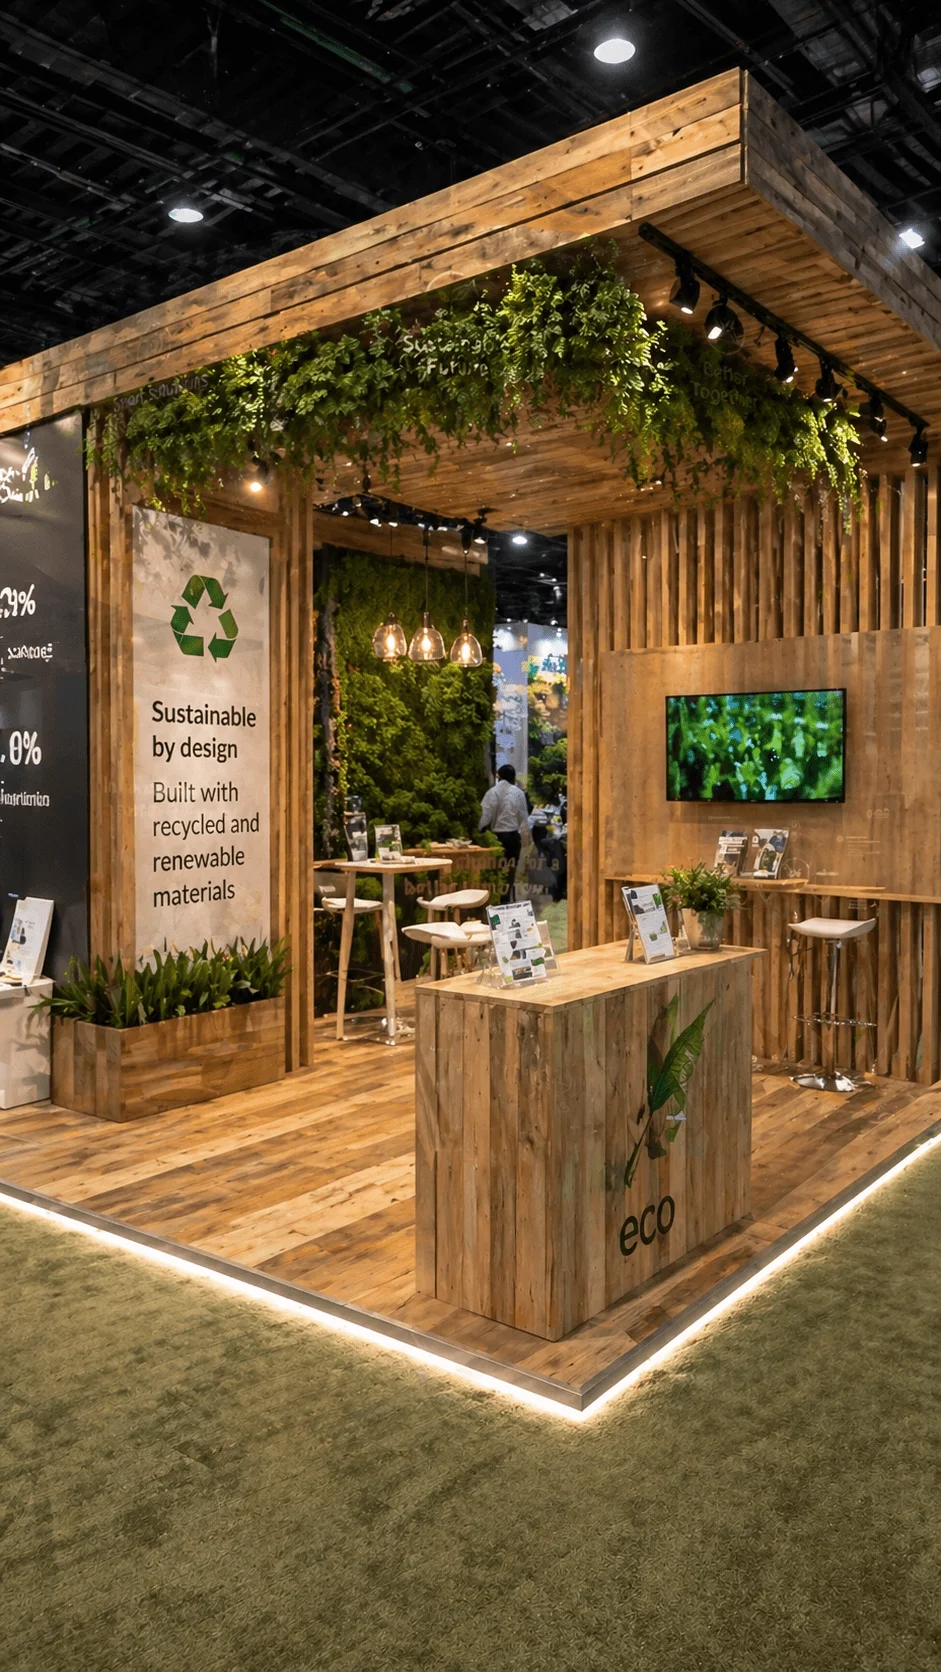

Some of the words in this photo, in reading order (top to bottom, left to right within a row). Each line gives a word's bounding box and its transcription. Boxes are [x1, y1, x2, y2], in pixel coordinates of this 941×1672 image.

[152, 700, 257, 728] Sustainable
[152, 735, 176, 763] by
[180, 736, 238, 764] design
[153, 781, 196, 803] Built
[200, 781, 239, 802] with
[153, 812, 226, 841] recycled
[230, 811, 260, 834] and
[153, 845, 246, 873] renewable
[153, 879, 236, 908] materials
[619, 1195, 676, 1257] eco
